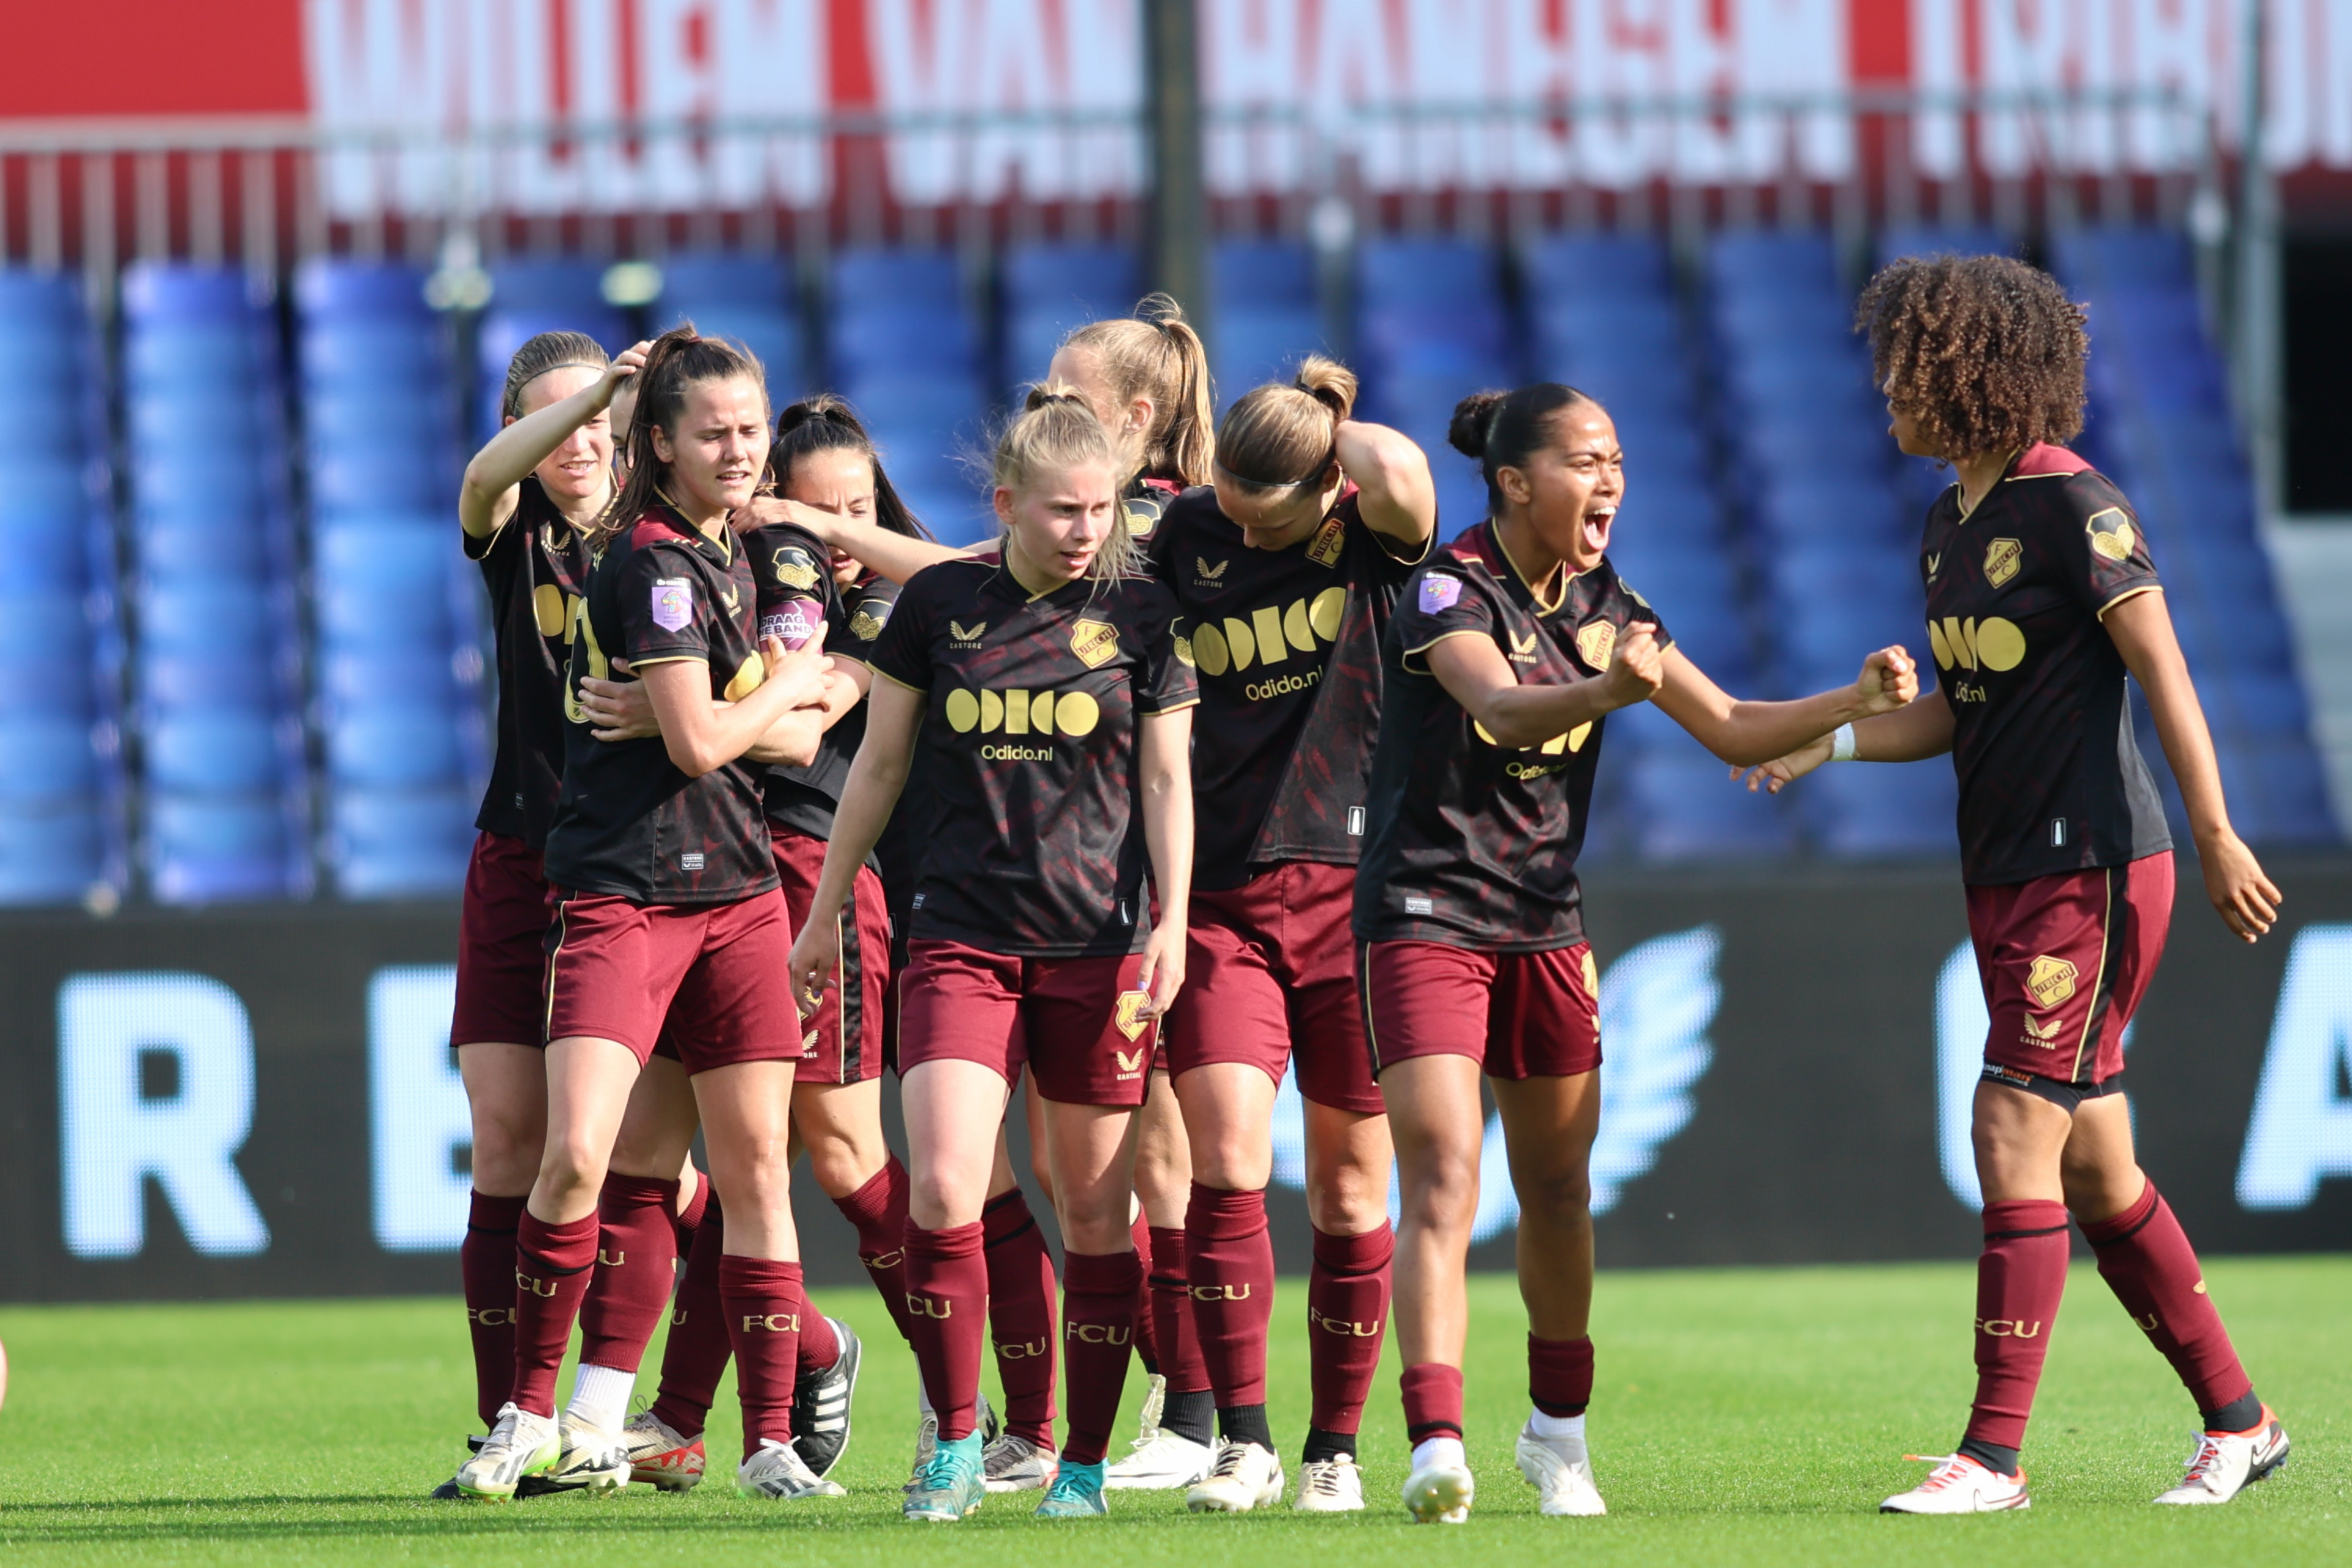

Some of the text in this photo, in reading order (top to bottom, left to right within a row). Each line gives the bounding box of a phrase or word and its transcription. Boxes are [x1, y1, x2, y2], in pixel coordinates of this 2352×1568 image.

[761, 614, 804, 627] DRAAG
[1077, 627, 1115, 655] UTRECHT
[1245, 665, 1324, 702] Odido.nl
[981, 744, 1054, 761] Odido.nl
[2033, 966, 2075, 995] UTRECHT
[2019, 1036, 2056, 1050] CASTORE
[1188, 1283, 1251, 1301] FCU
[1066, 1321, 1130, 1345] FCU
[1311, 1306, 1379, 1336] FCU
